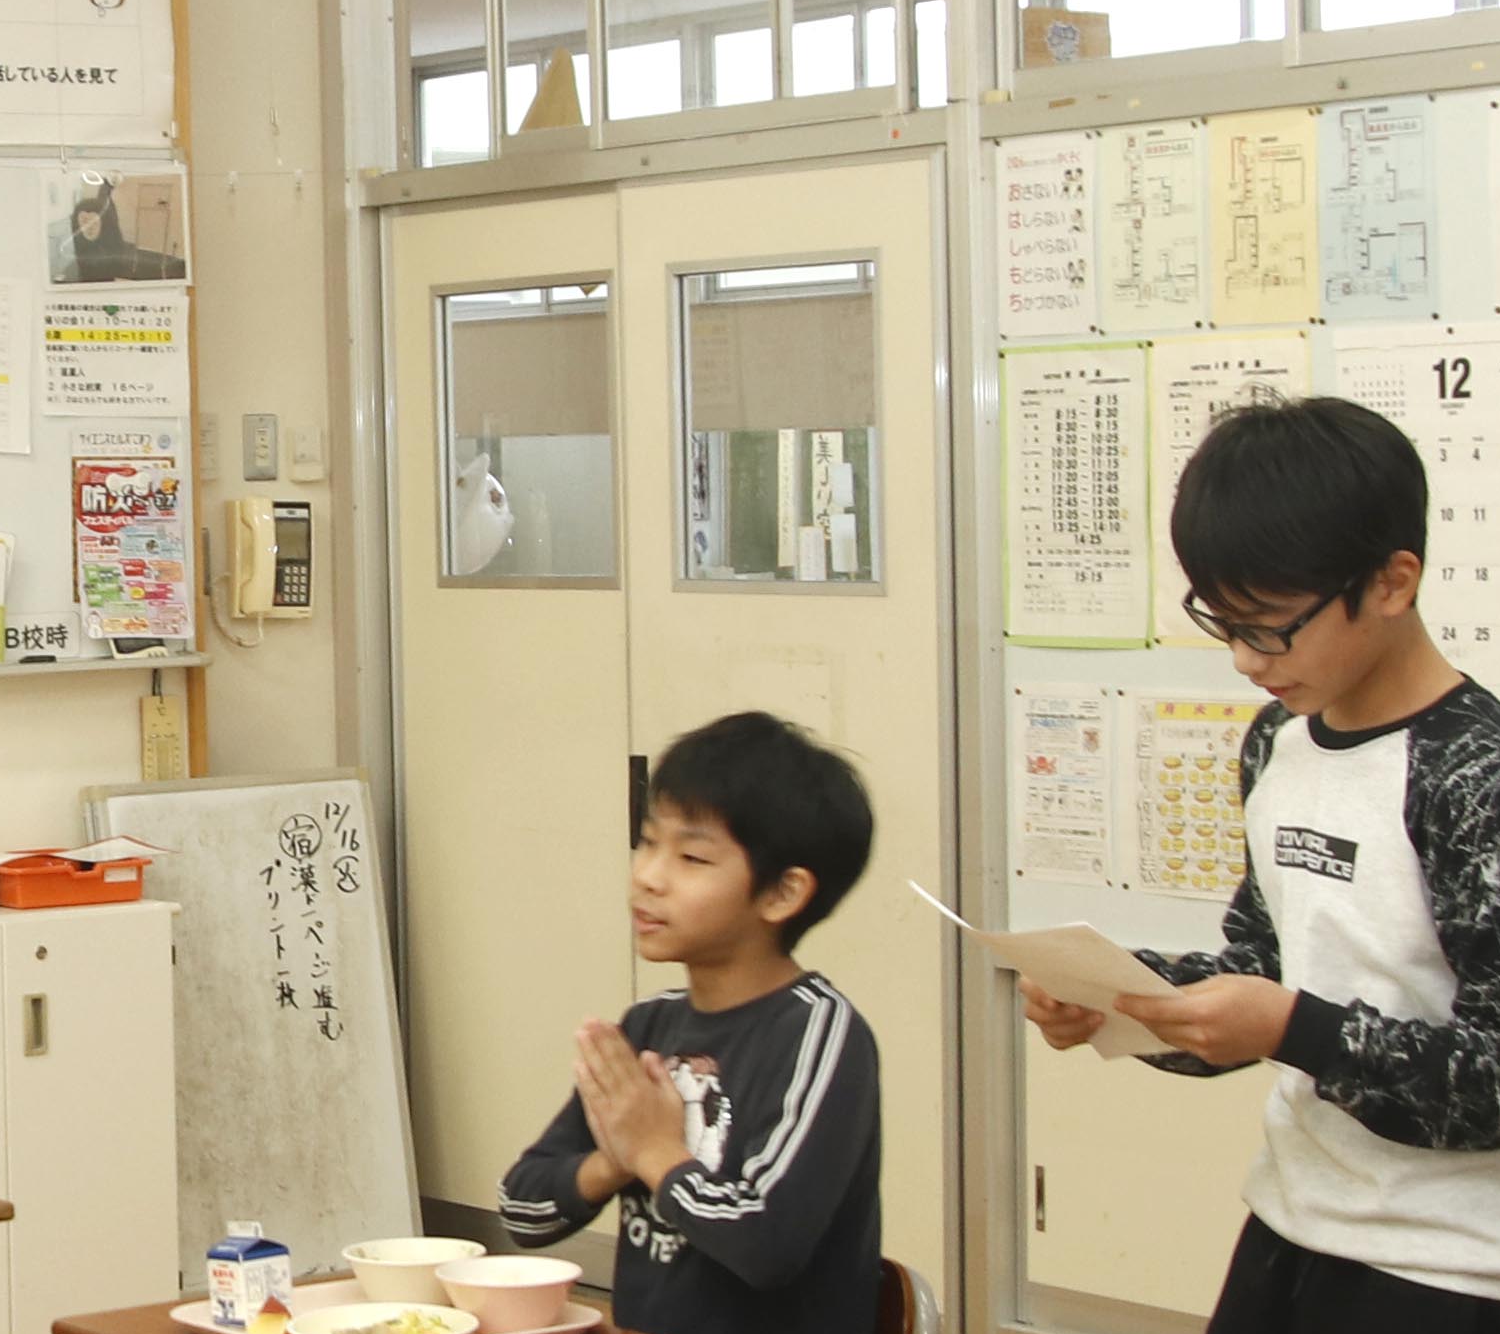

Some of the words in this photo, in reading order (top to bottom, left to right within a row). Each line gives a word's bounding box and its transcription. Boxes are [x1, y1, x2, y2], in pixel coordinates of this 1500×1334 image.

[1432, 357, 1472, 400] 12
[1440, 508, 1454, 522] 10
[1473, 507, 1486, 522] 11
[1441, 567, 1455, 582] 17
[1474, 567, 1489, 582] 18
[4, 624, 70, 650] B校時
[1441, 627, 1457, 641] 24
[1474, 628, 1490, 642] 25
